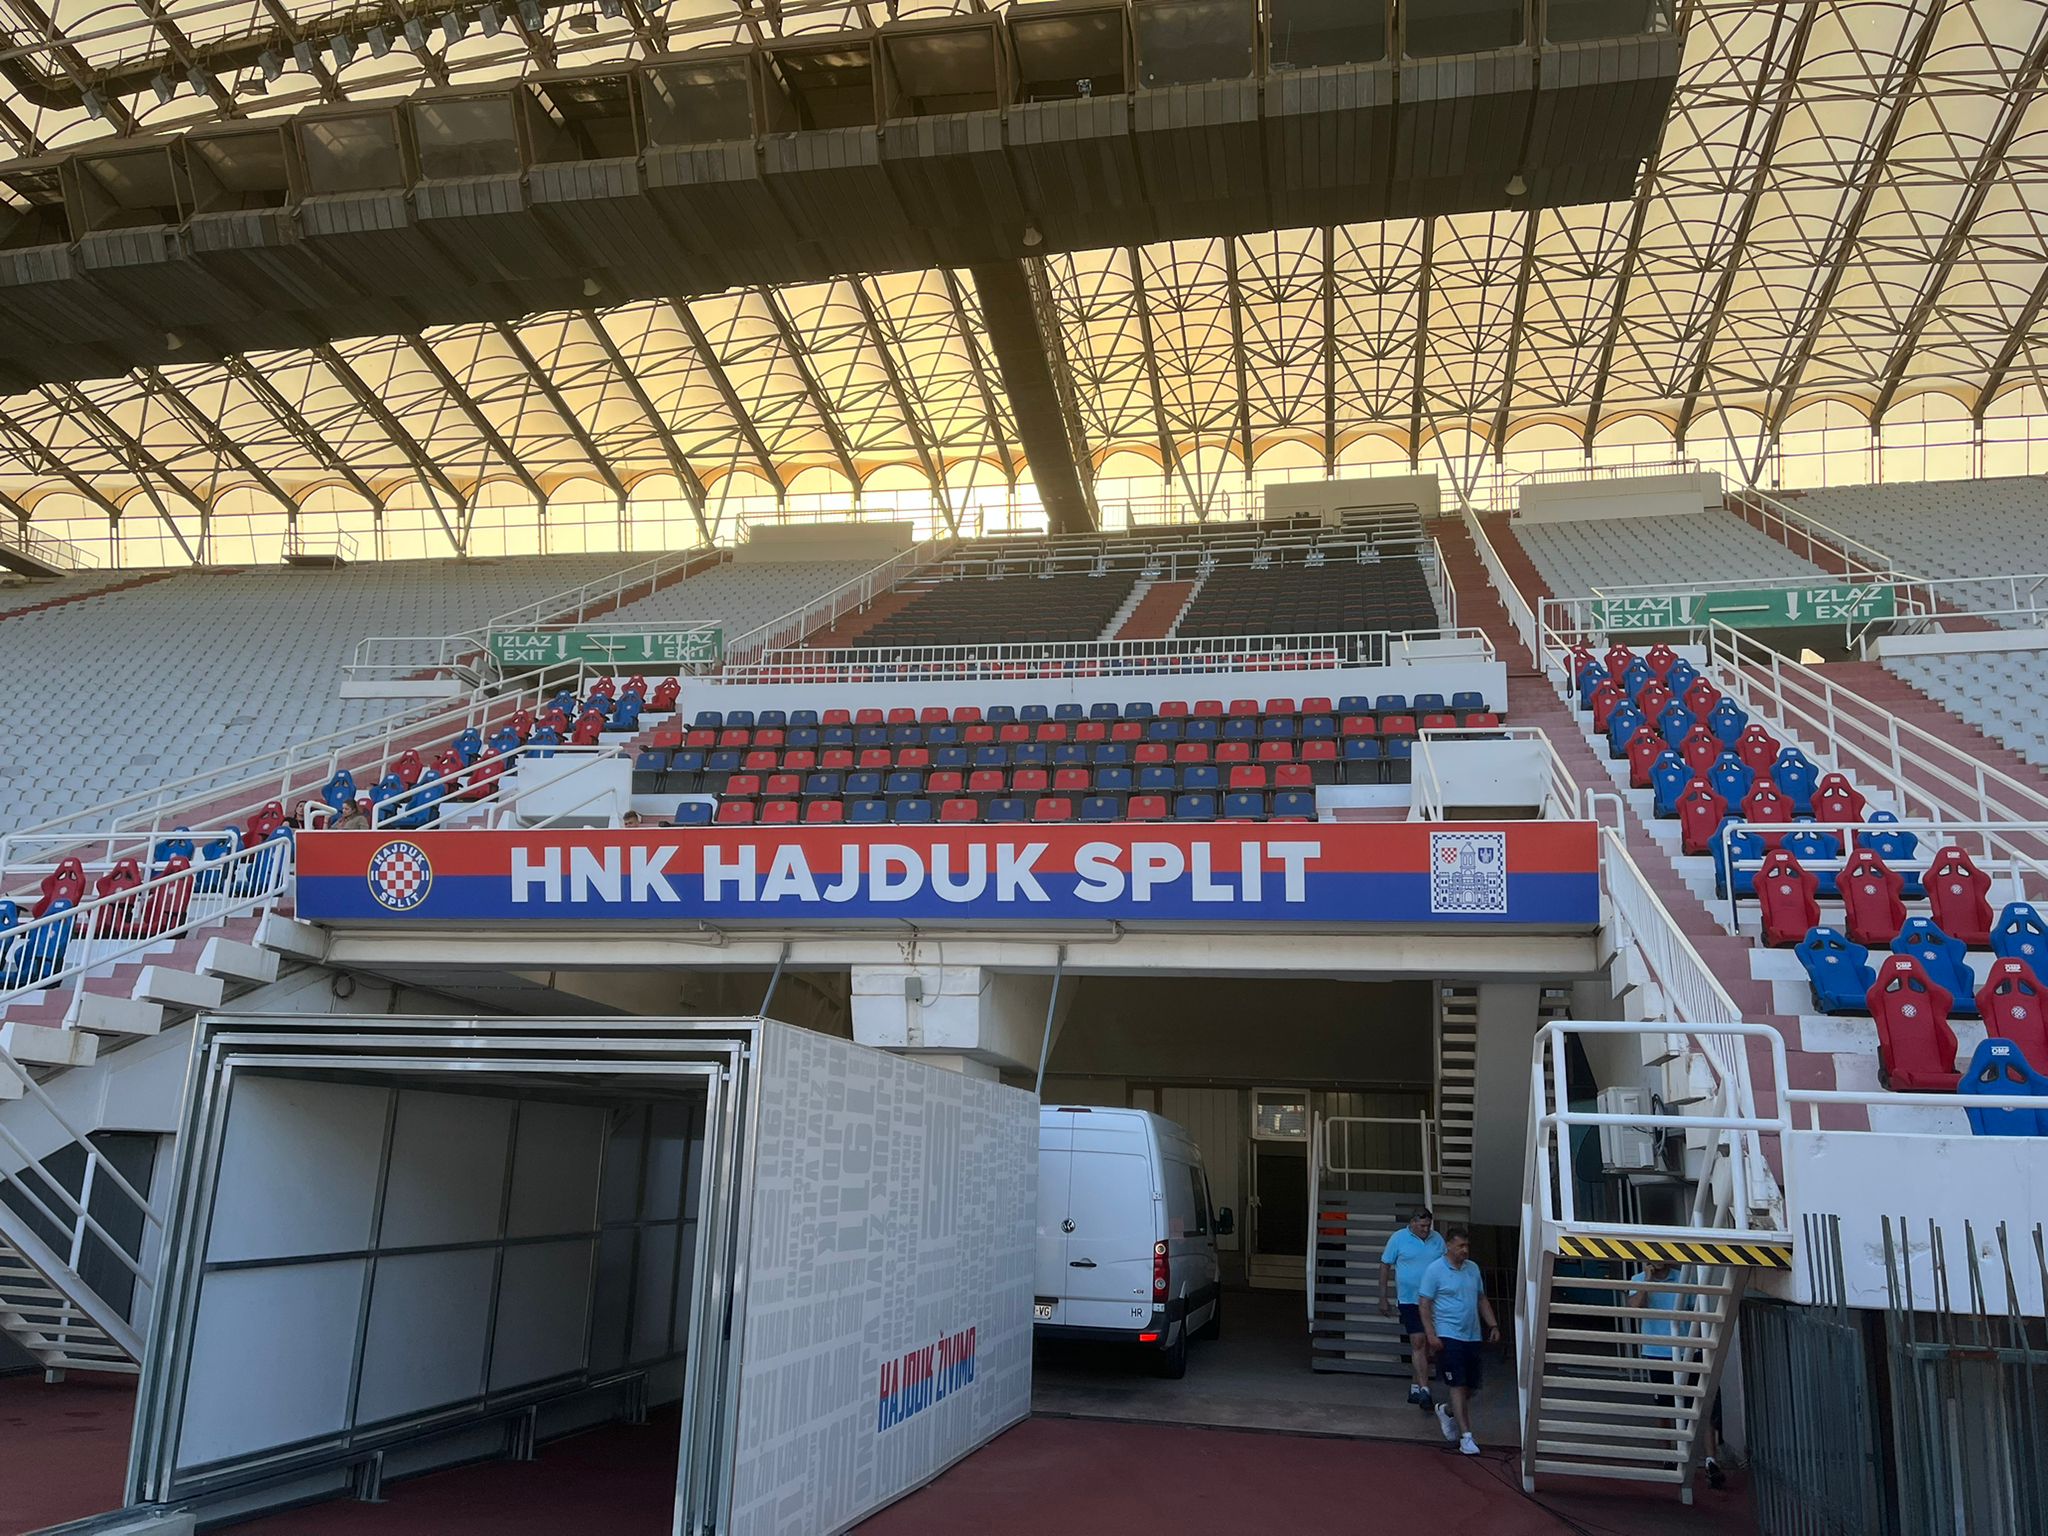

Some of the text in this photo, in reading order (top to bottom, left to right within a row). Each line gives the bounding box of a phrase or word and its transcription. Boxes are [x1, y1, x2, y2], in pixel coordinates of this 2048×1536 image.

[1807, 586, 1882, 603] IZLAZ
[1602, 598, 1670, 612] IZLAZ
[1816, 603, 1873, 619] EXIT
[1610, 613, 1664, 628] EXIT
[498, 635, 552, 647] IZLAZ
[504, 649, 546, 661] EXIT
[374, 844, 425, 866] HAJDUK
[511, 841, 1321, 903] HNK HAJDUK SPLIT
[379, 892, 420, 908] SPLIT
[1991, 1046, 2010, 1056] OMP
[871, 1053, 892, 1200] AJDUK
[837, 1079, 874, 1251] 1911
[920, 1098, 961, 1240] 1911
[1131, 1307, 1143, 1318] HR
[879, 1343, 935, 1434] HAJDUK
[935, 1328, 976, 1402] ŽIVIMO
